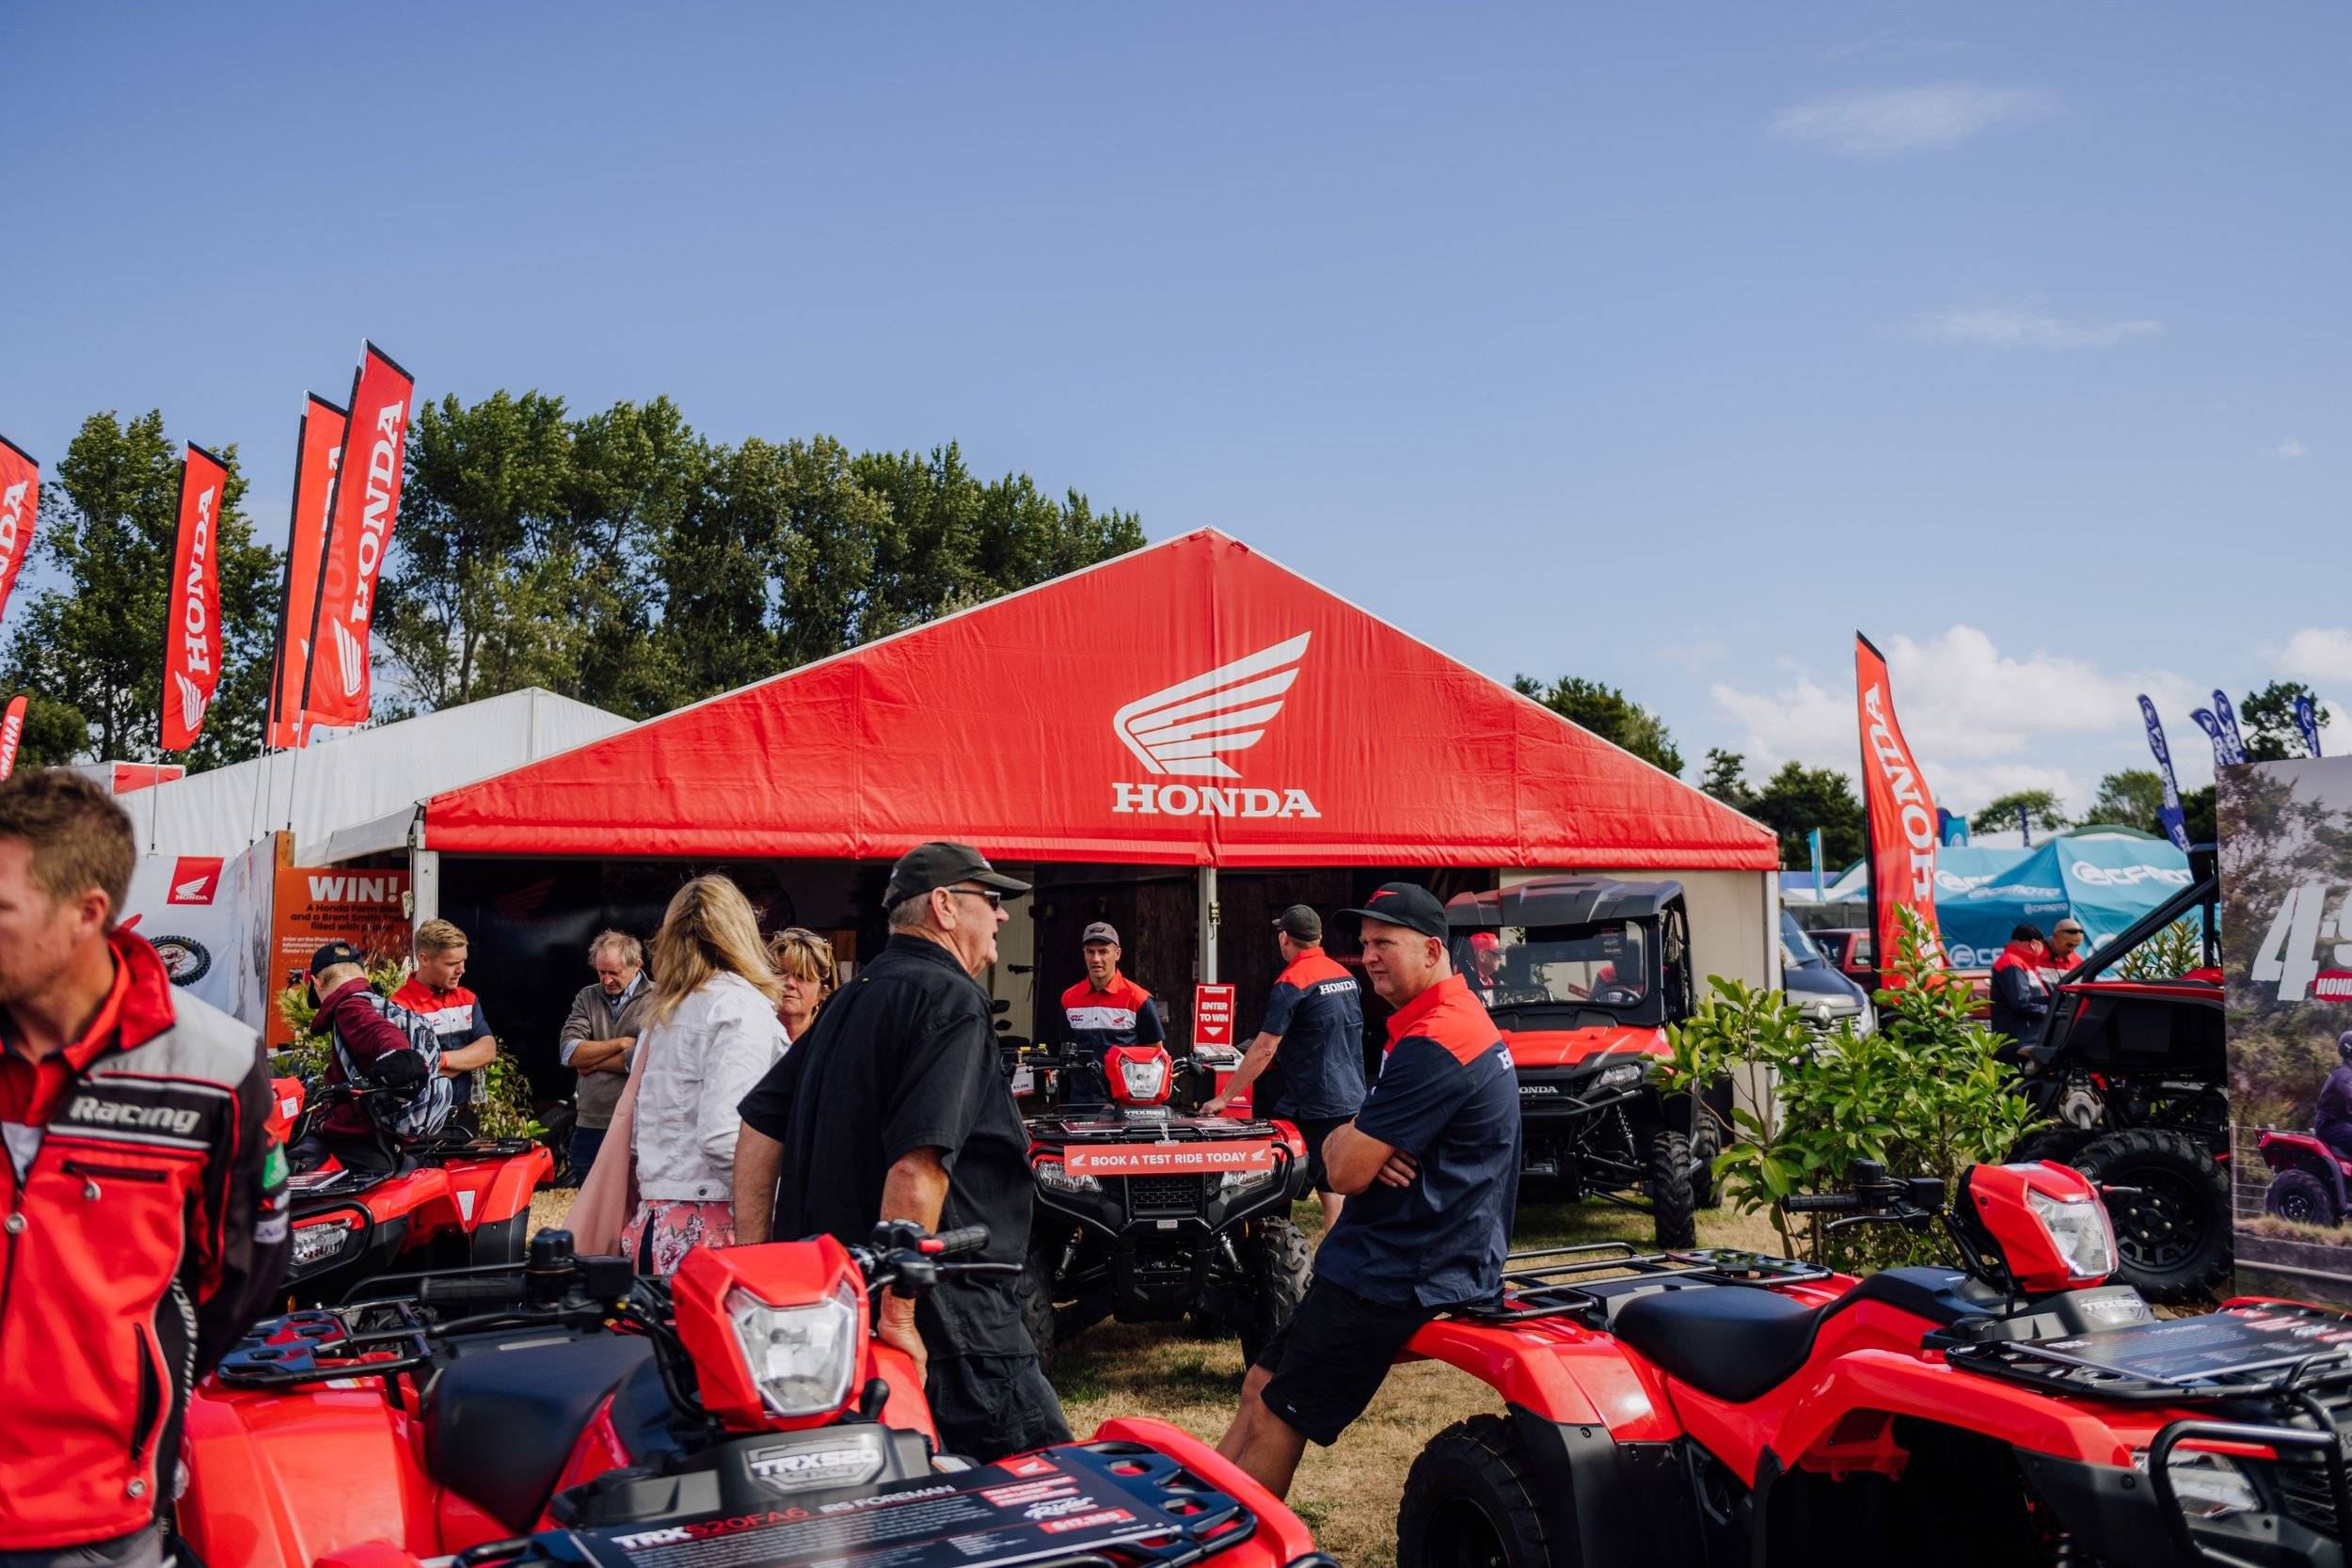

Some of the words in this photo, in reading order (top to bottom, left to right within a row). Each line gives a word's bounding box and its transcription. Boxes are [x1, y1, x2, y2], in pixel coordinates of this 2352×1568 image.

[351, 400, 405, 623] HONDA
[184, 485, 215, 675] HONDA
[1112, 783, 1322, 817] HONDA
[1865, 682, 1934, 901] HONDA
[309, 876, 398, 903] WIN!
[311, 922, 335, 930] filled
[323, 912, 349, 921] Brent
[352, 913, 381, 922] Smith
[1319, 980, 1358, 994] HONDA
[1200, 1014, 1213, 1022] TO
[1201, 1002, 1228, 1010] ENTER
[1518, 1085, 1559, 1094] ONDA
[70, 1095, 201, 1134] Racing
[1090, 1156, 1127, 1166] BOOK
[1130, 1156, 1139, 1165] A
[1142, 1154, 1171, 1164] TEST
[1175, 1153, 1203, 1164] RIDE
[1206, 1152, 1247, 1163] TODAY
[751, 1449, 881, 1476] TRX520
[854, 1484, 957, 1508] FOREMAN
